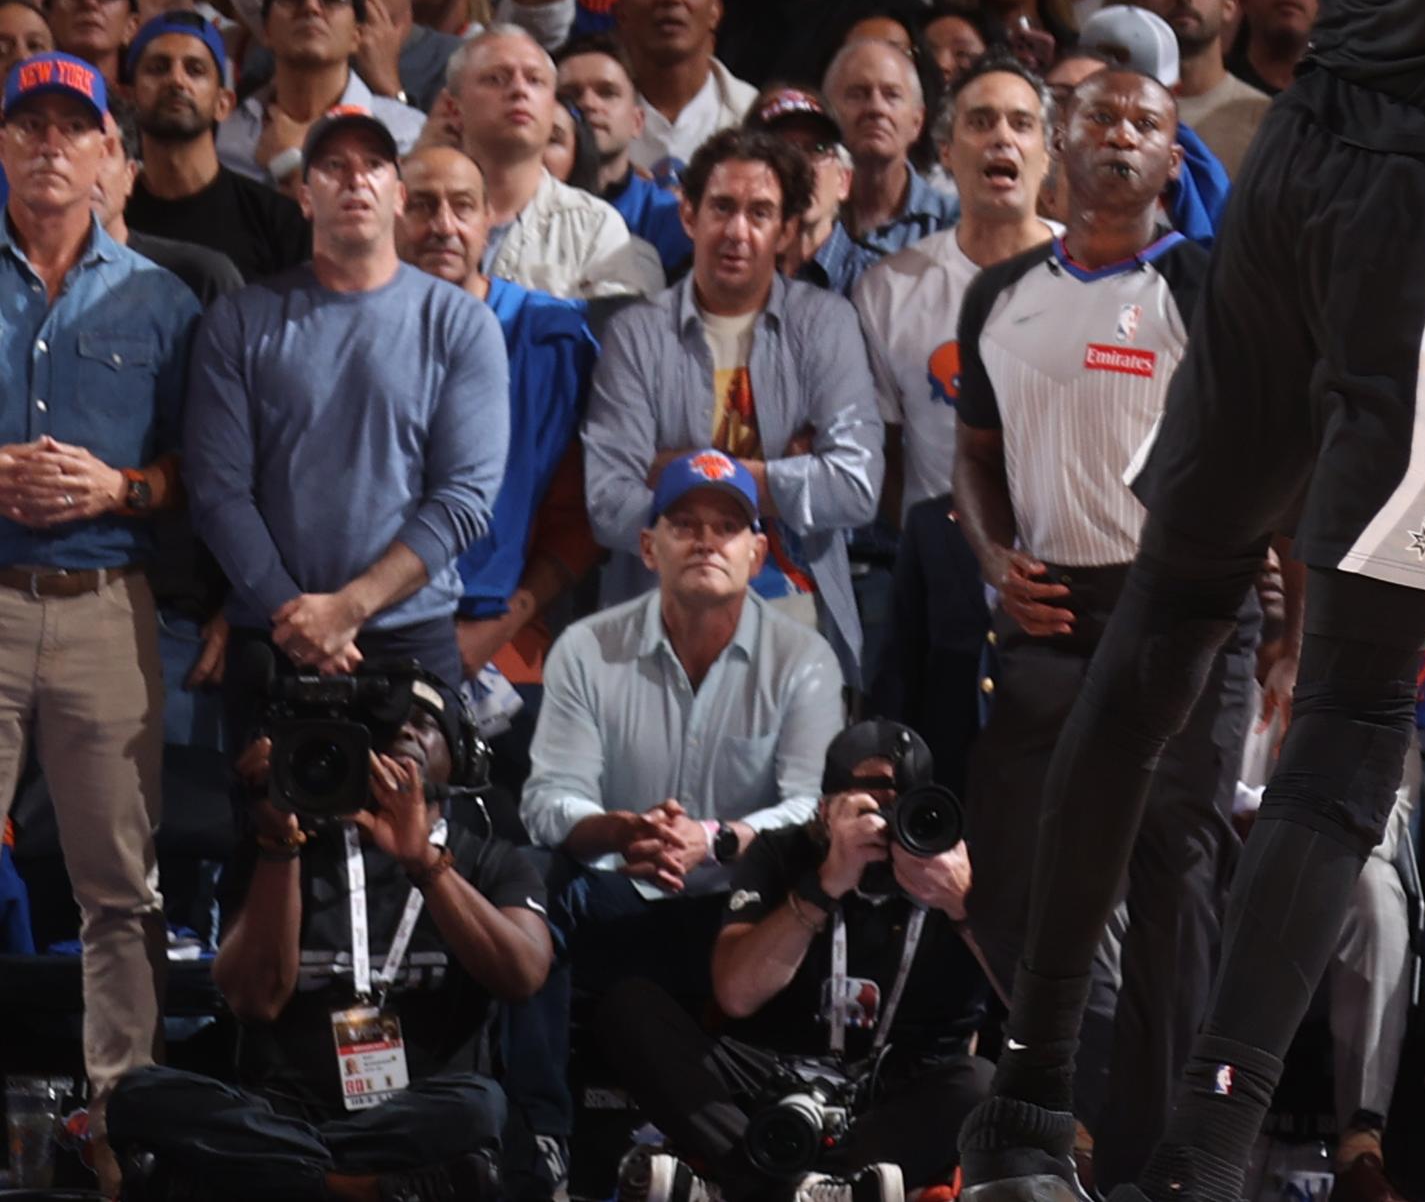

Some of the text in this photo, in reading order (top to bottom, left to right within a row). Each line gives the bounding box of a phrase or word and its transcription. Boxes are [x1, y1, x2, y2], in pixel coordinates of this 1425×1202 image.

[20, 60, 97, 97] NEW YORK
[1087, 348, 1155, 371] Emirates
